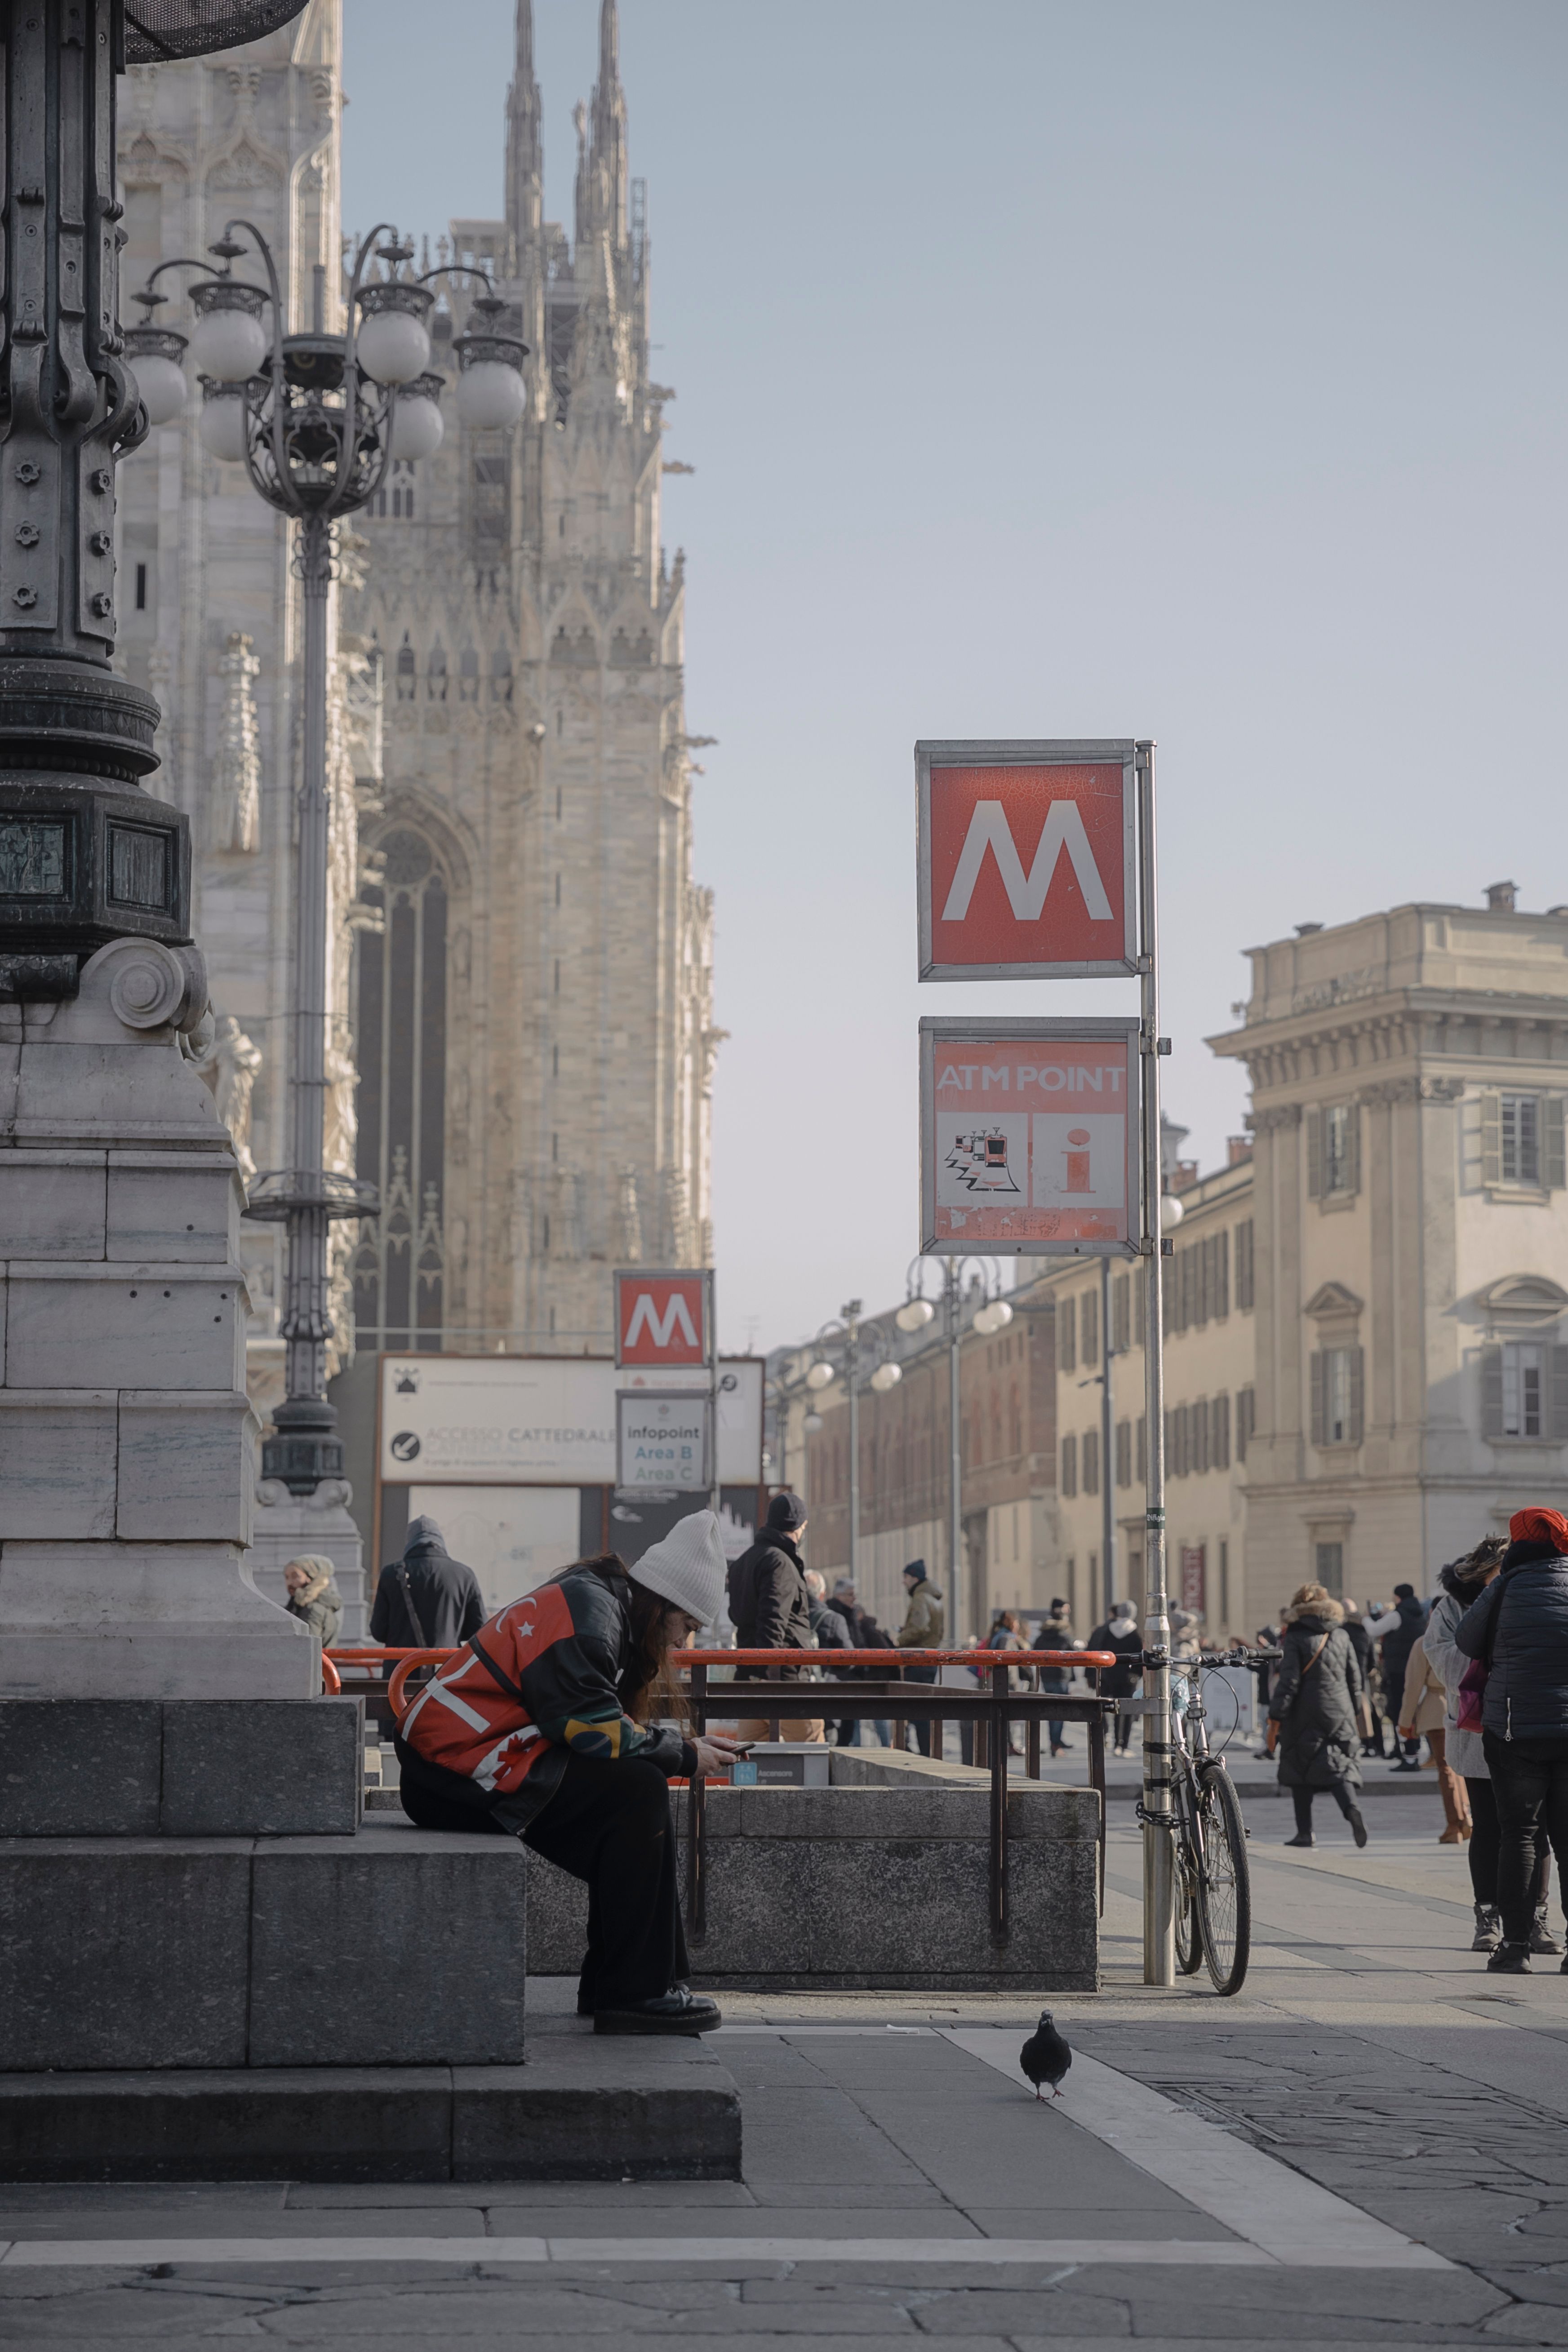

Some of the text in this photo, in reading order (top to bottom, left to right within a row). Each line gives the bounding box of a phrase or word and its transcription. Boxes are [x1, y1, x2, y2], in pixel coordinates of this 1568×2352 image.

[941, 799, 1115, 921] M
[936, 1065, 1126, 1092] ATM POINT
[624, 1293, 699, 1348] M
[425, 1427, 502, 1443] ACCESSO
[627, 1425, 700, 1441] infopoint
[635, 1445, 693, 1460] Area B
[635, 1466, 693, 1481] Area C
